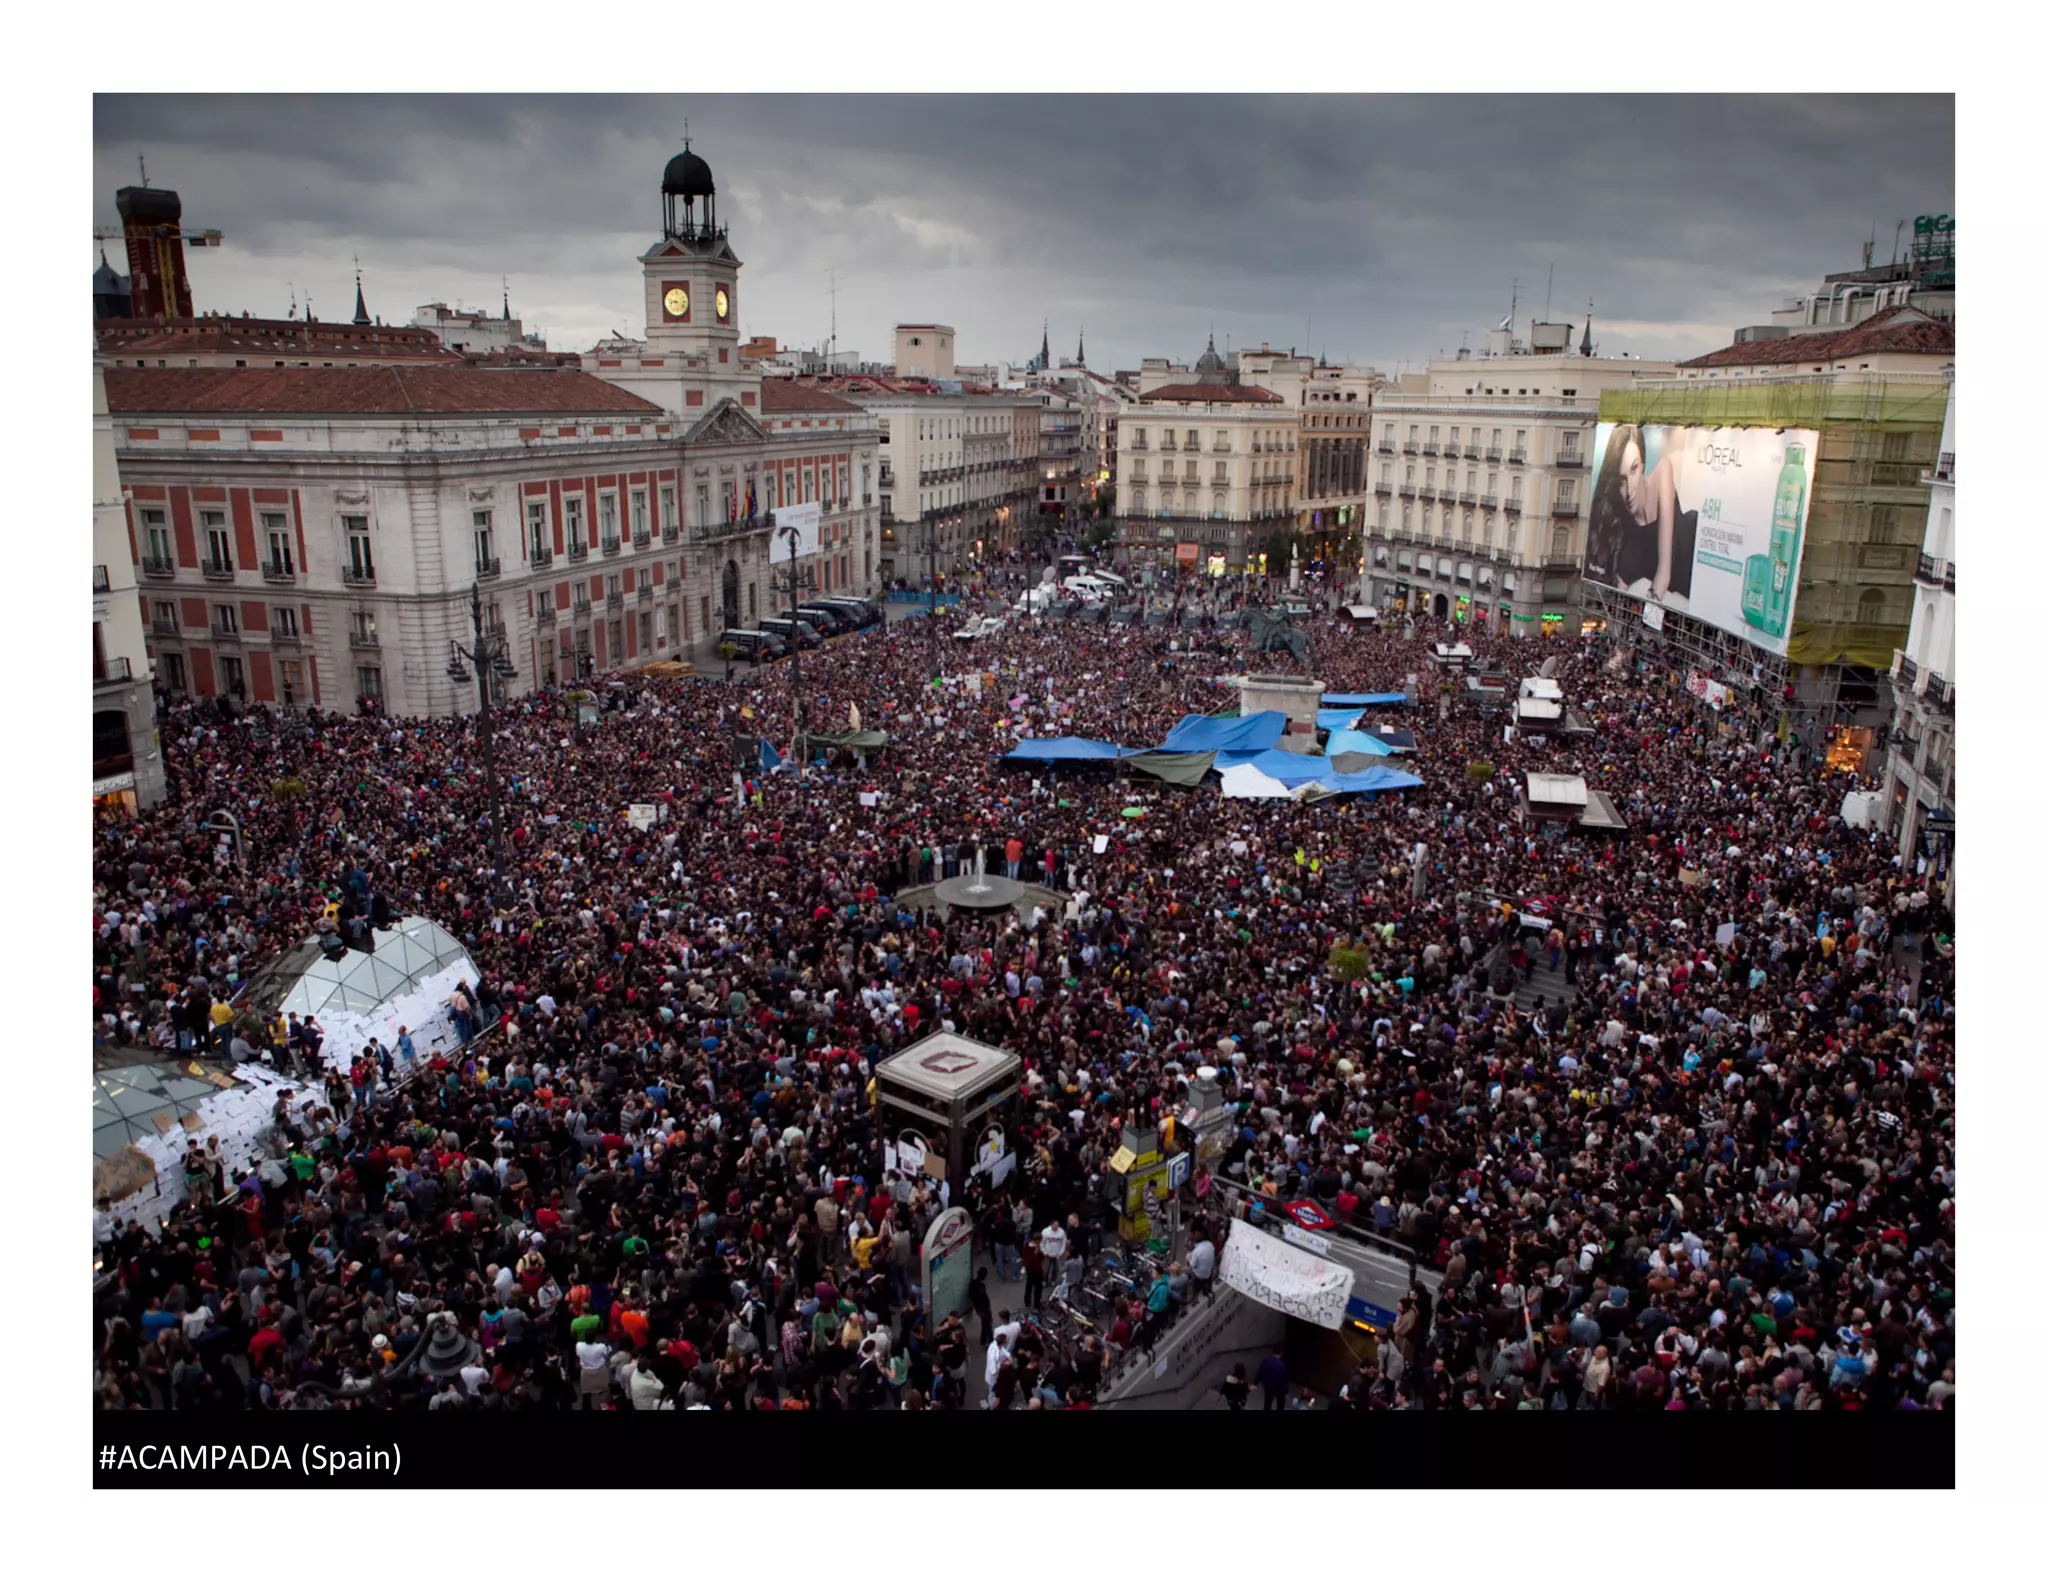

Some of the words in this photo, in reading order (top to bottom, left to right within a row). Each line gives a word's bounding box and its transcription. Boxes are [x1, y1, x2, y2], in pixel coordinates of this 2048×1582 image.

[1701, 497, 1722, 521] 48H
[1175, 1161, 1186, 1185] P
[1297, 1208, 1318, 1223] Metro
